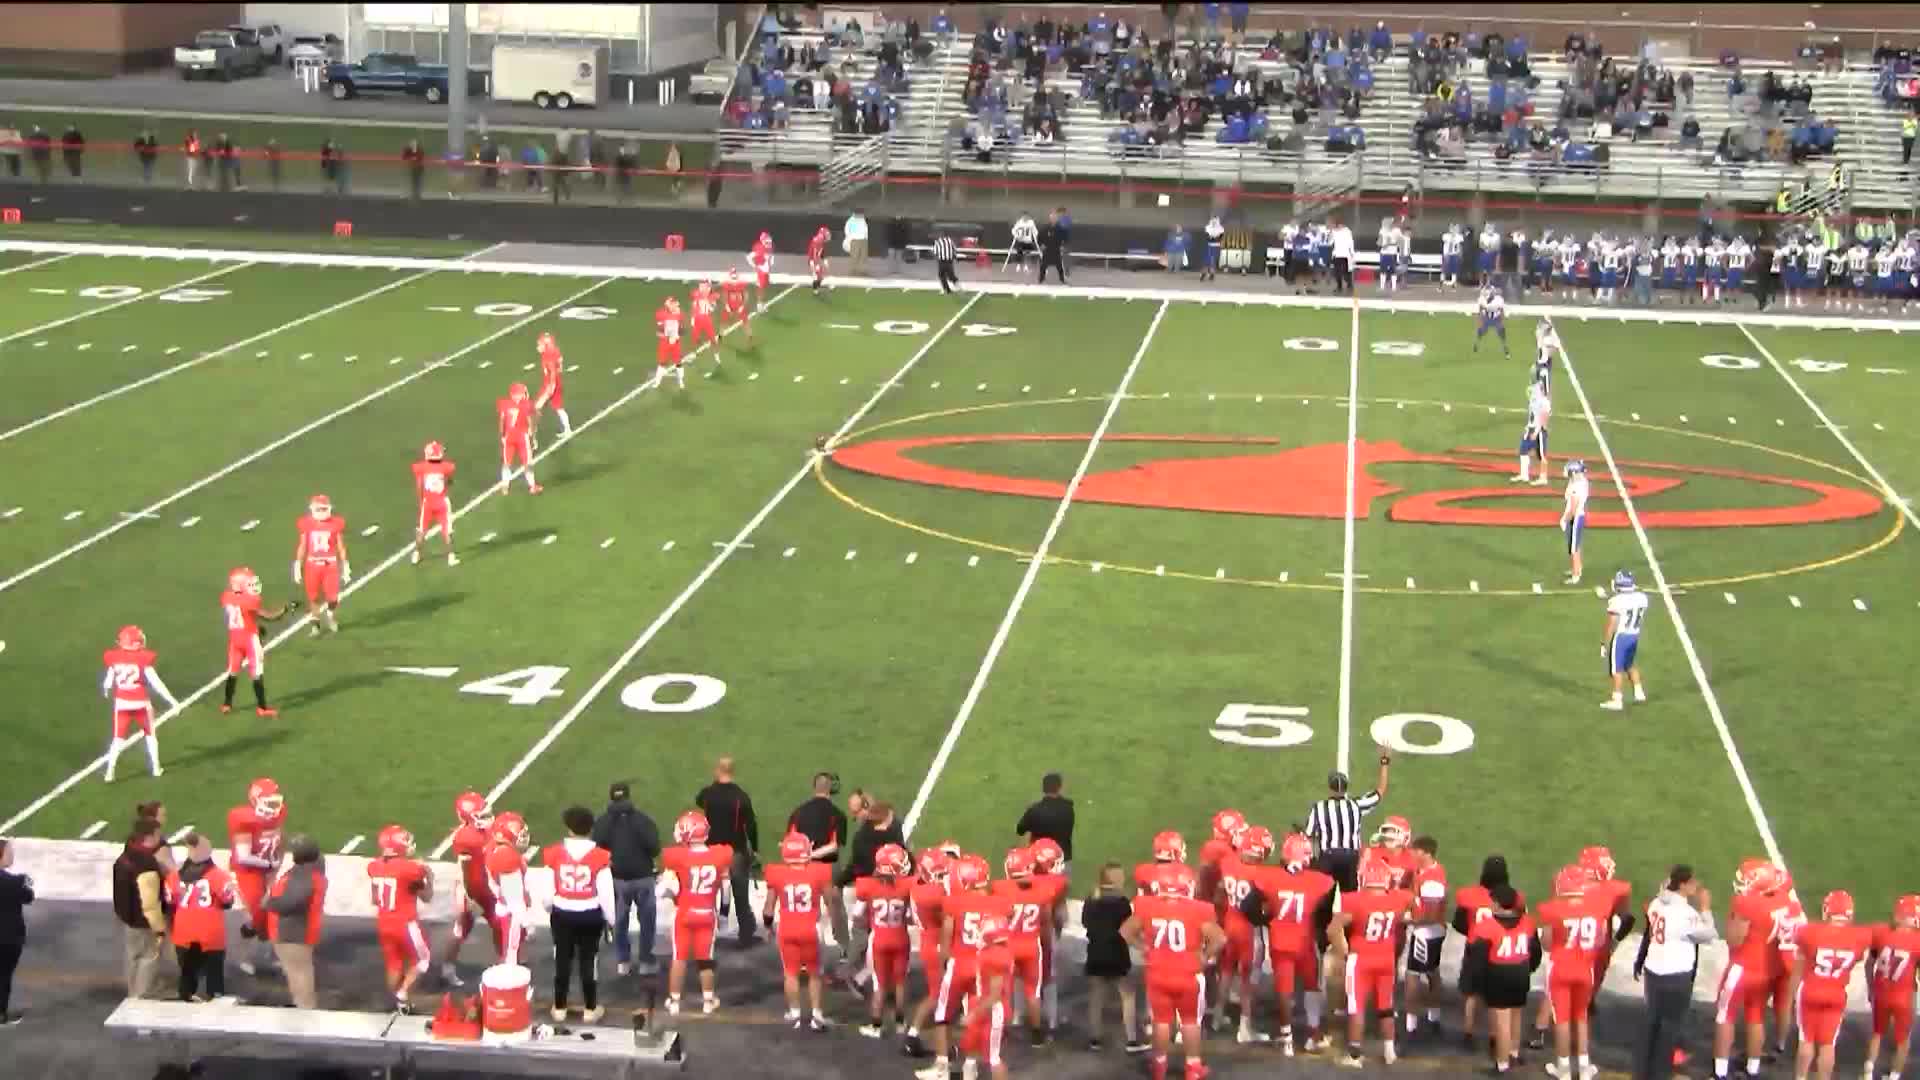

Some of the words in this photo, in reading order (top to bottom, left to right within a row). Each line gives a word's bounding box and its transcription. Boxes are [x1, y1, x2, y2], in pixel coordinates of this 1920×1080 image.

[113, 664, 141, 690] 22
[180, 879, 212, 907] 73
[560, 863, 591, 893] 52
[690, 864, 717, 895] 12
[372, 876, 397, 914] 77
[783, 883, 812, 912] 13
[1278, 890, 1304, 923] 71
[1008, 903, 1039, 933] 72
[1365, 912, 1395, 943] 61
[1563, 916, 1597, 950] 79
[1152, 919, 1185, 953] 70
[1497, 933, 1529, 959] 44
[1814, 947, 1854, 979] 57
